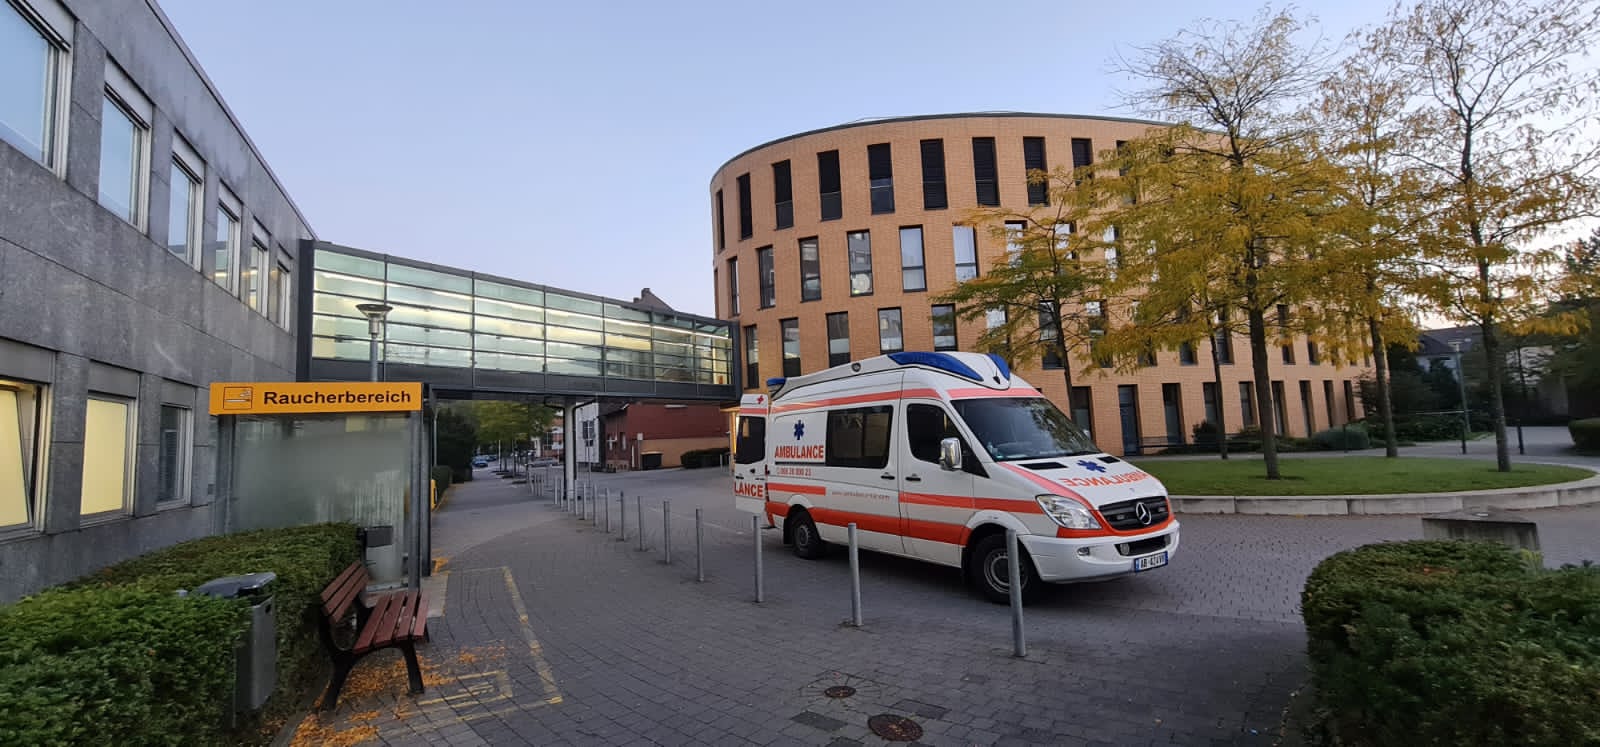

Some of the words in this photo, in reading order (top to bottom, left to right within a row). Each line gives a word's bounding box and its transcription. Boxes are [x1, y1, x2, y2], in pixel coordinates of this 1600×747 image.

[264, 391, 411, 405] Raucherbereich
[774, 445, 824, 459] AMBULANCE
[734, 481, 763, 498] LANCE
